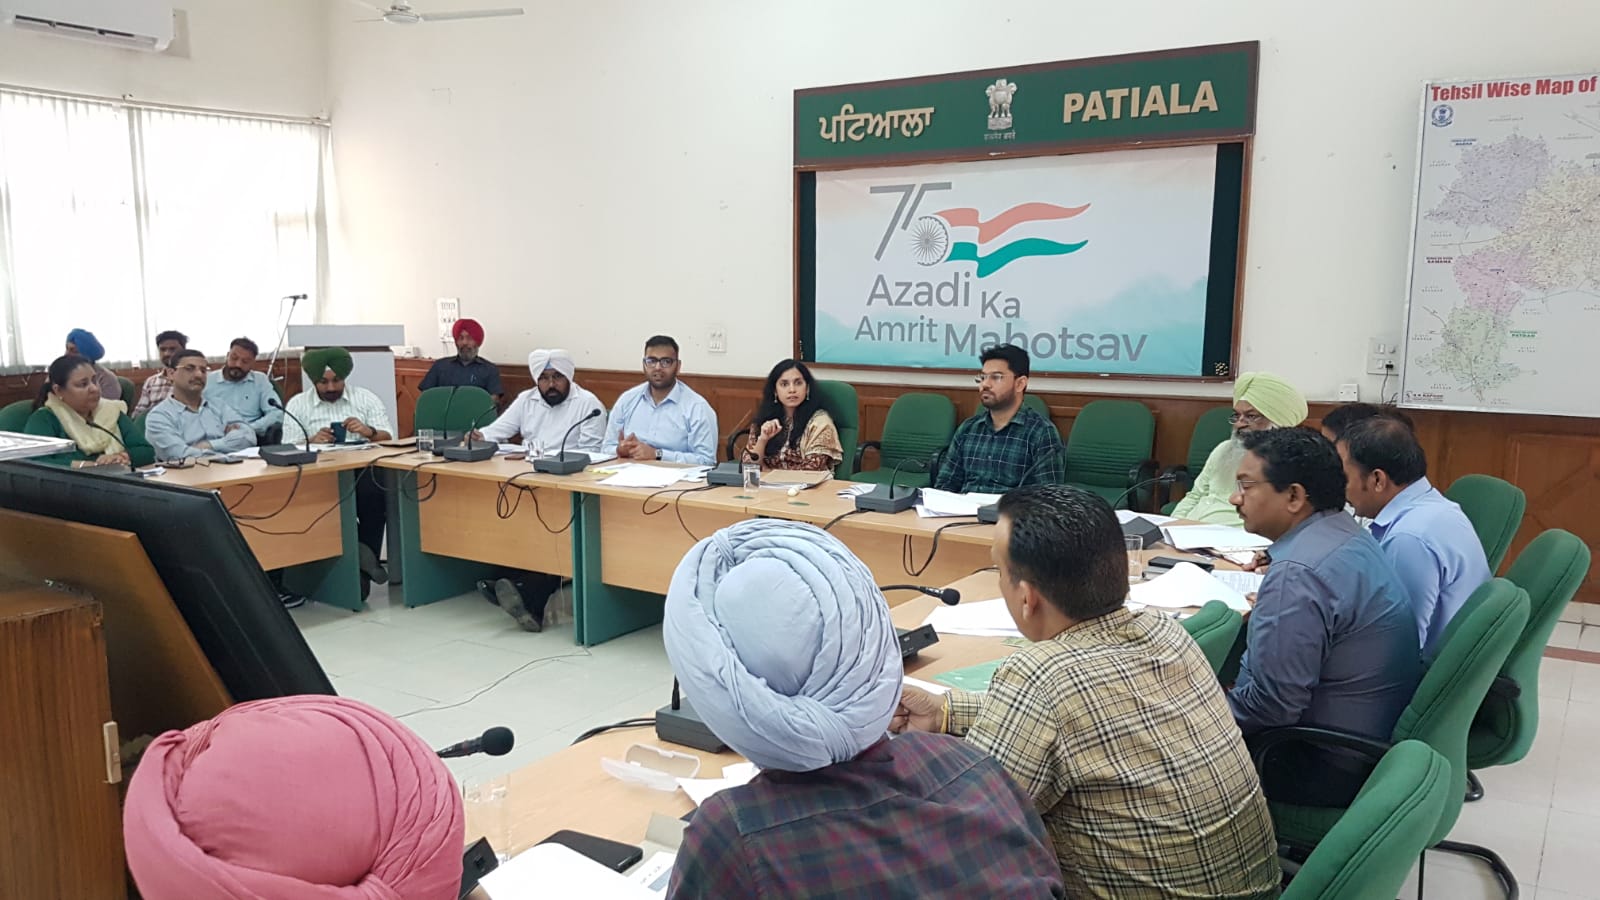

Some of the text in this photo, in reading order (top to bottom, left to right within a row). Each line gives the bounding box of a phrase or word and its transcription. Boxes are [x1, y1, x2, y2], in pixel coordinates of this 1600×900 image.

[1063, 80, 1218, 124] PATIALA
[1431, 76, 1598, 101] Tehsil Wise Map of
[818, 103, 935, 143] ਪਟਿਆਲਾ
[866, 271, 1021, 319] Azadi Ka
[854, 315, 1148, 362] Amrit Mahotsav
